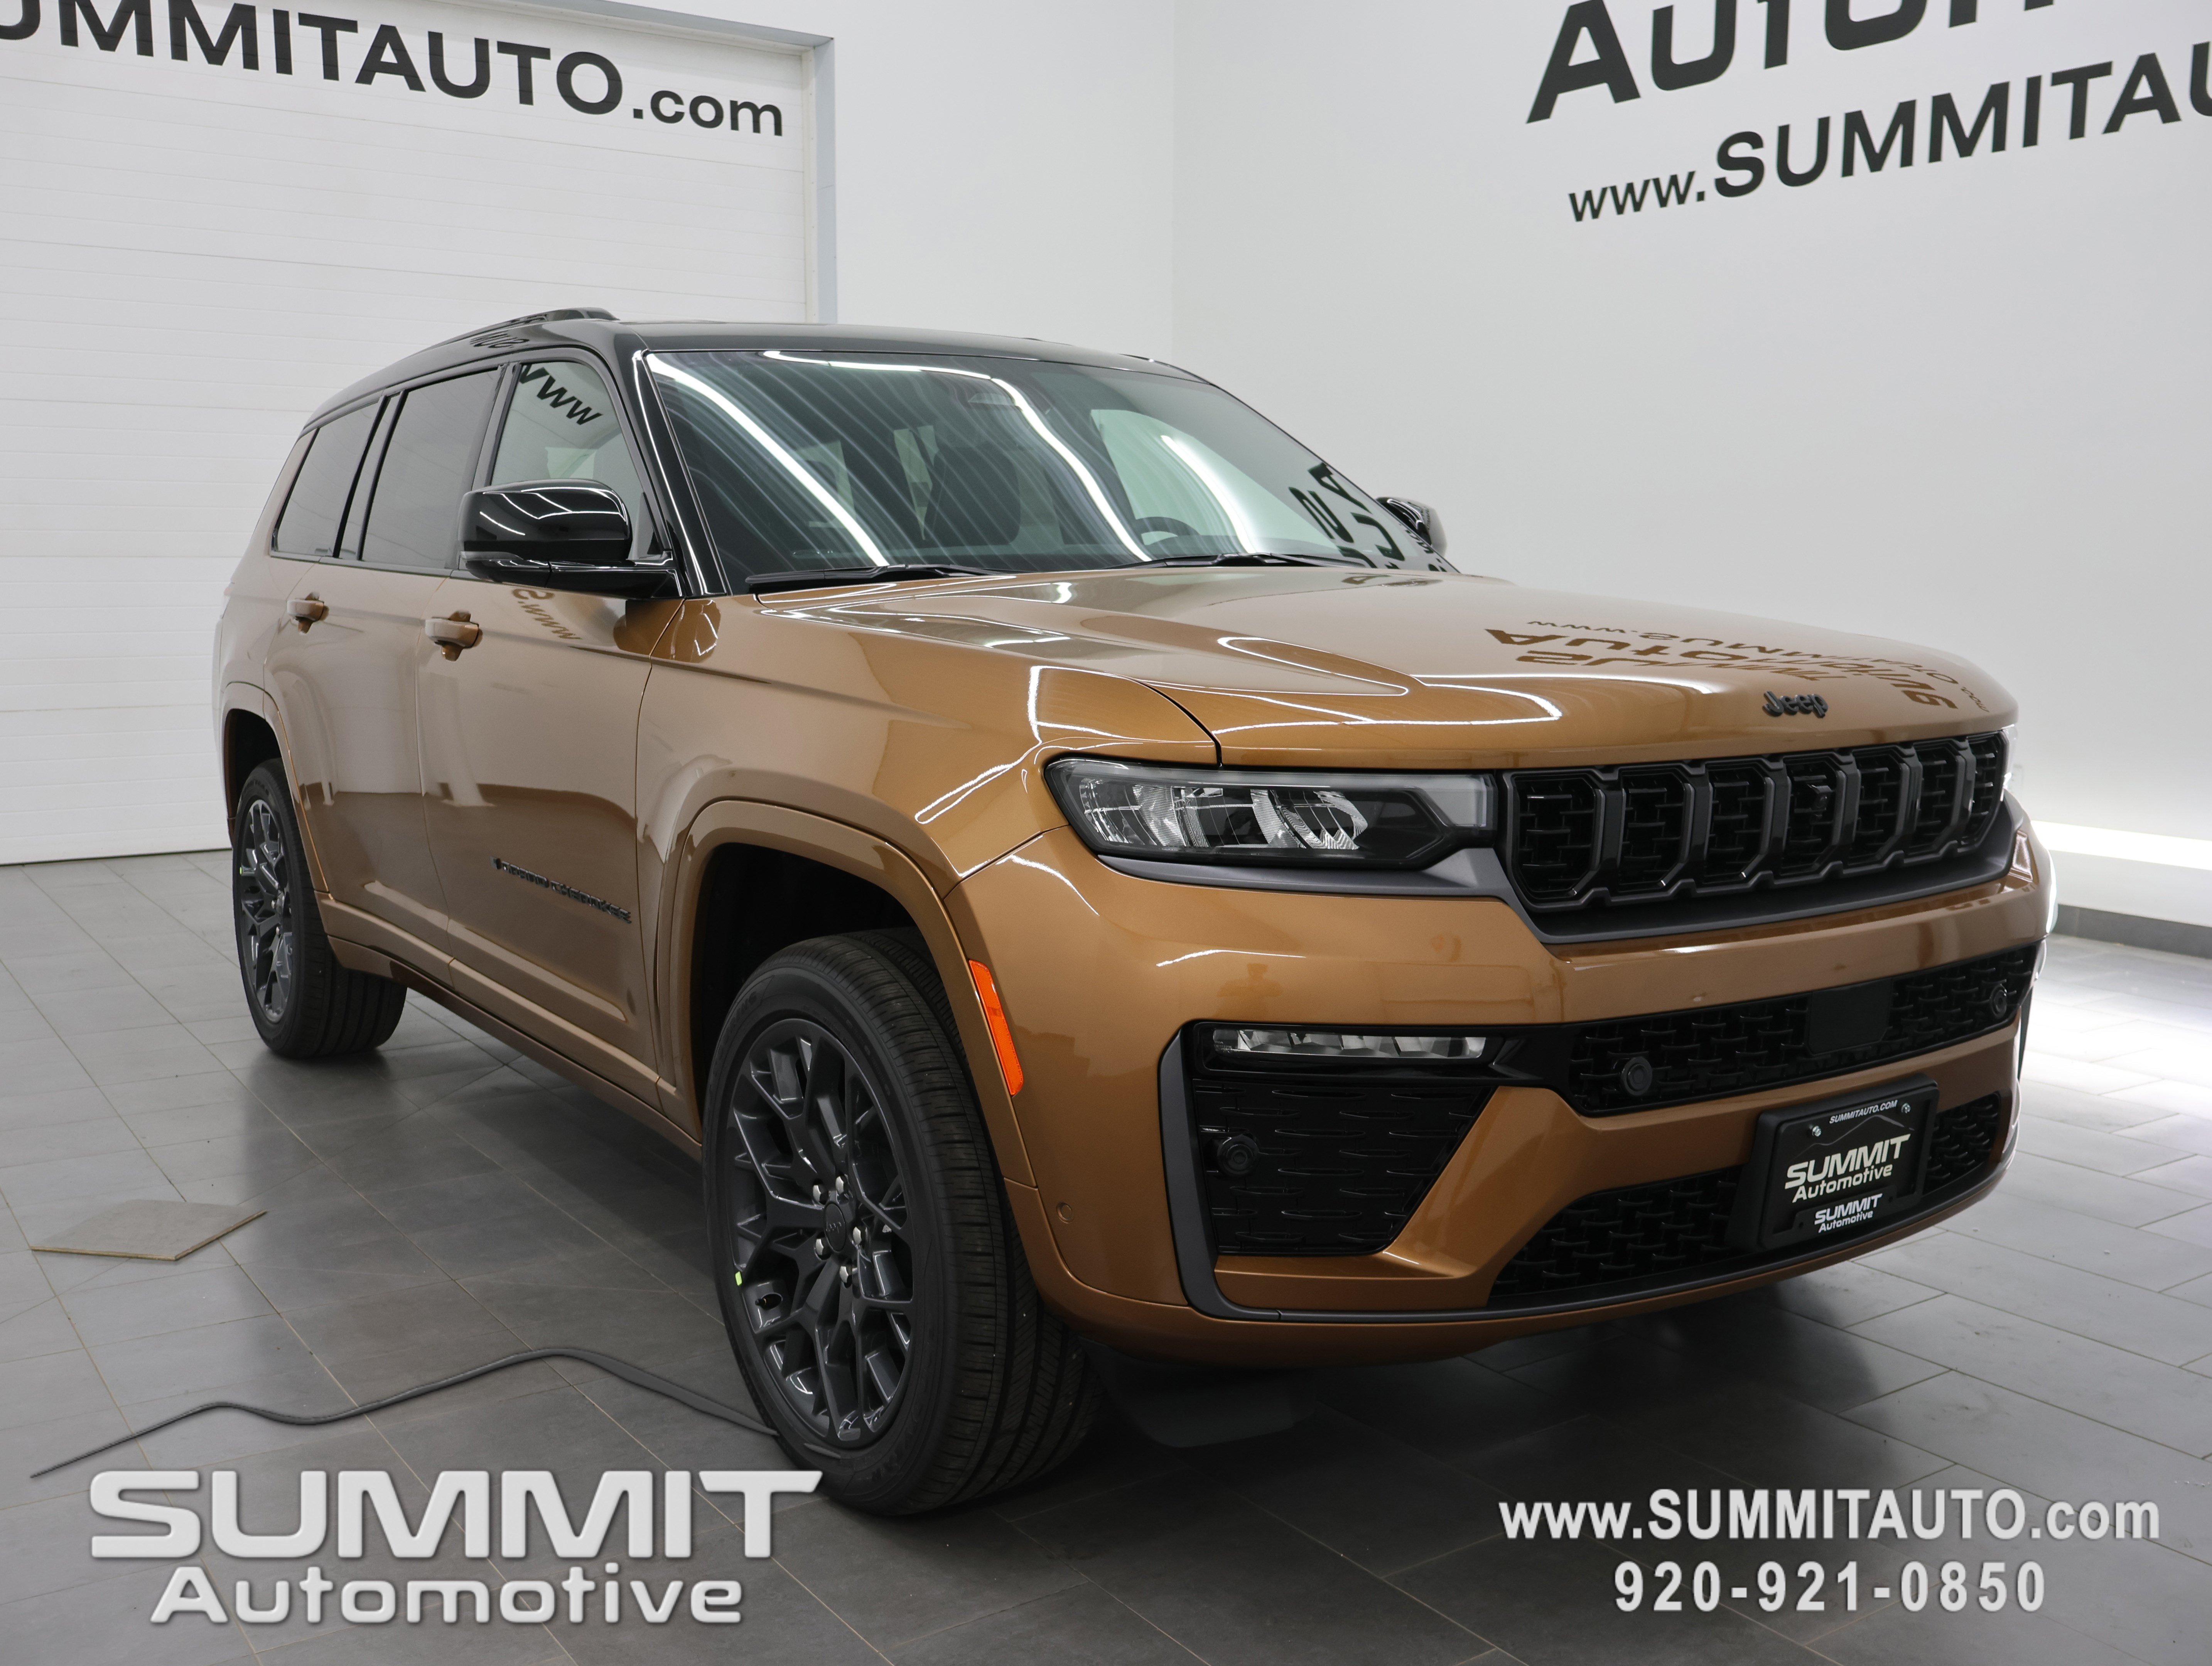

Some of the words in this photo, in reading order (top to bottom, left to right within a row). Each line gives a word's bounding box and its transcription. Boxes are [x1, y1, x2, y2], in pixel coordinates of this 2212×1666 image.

[1762, 691, 1829, 718] Jeep
[1829, 1099, 1898, 1125] SUMMITAUTO.COM
[1785, 1134, 1911, 1189] SUMMIT
[1792, 1164, 1893, 1203] Automotive
[1814, 1193, 1883, 1225] SUMMIT
[1818, 1211, 1873, 1233] Automotive
